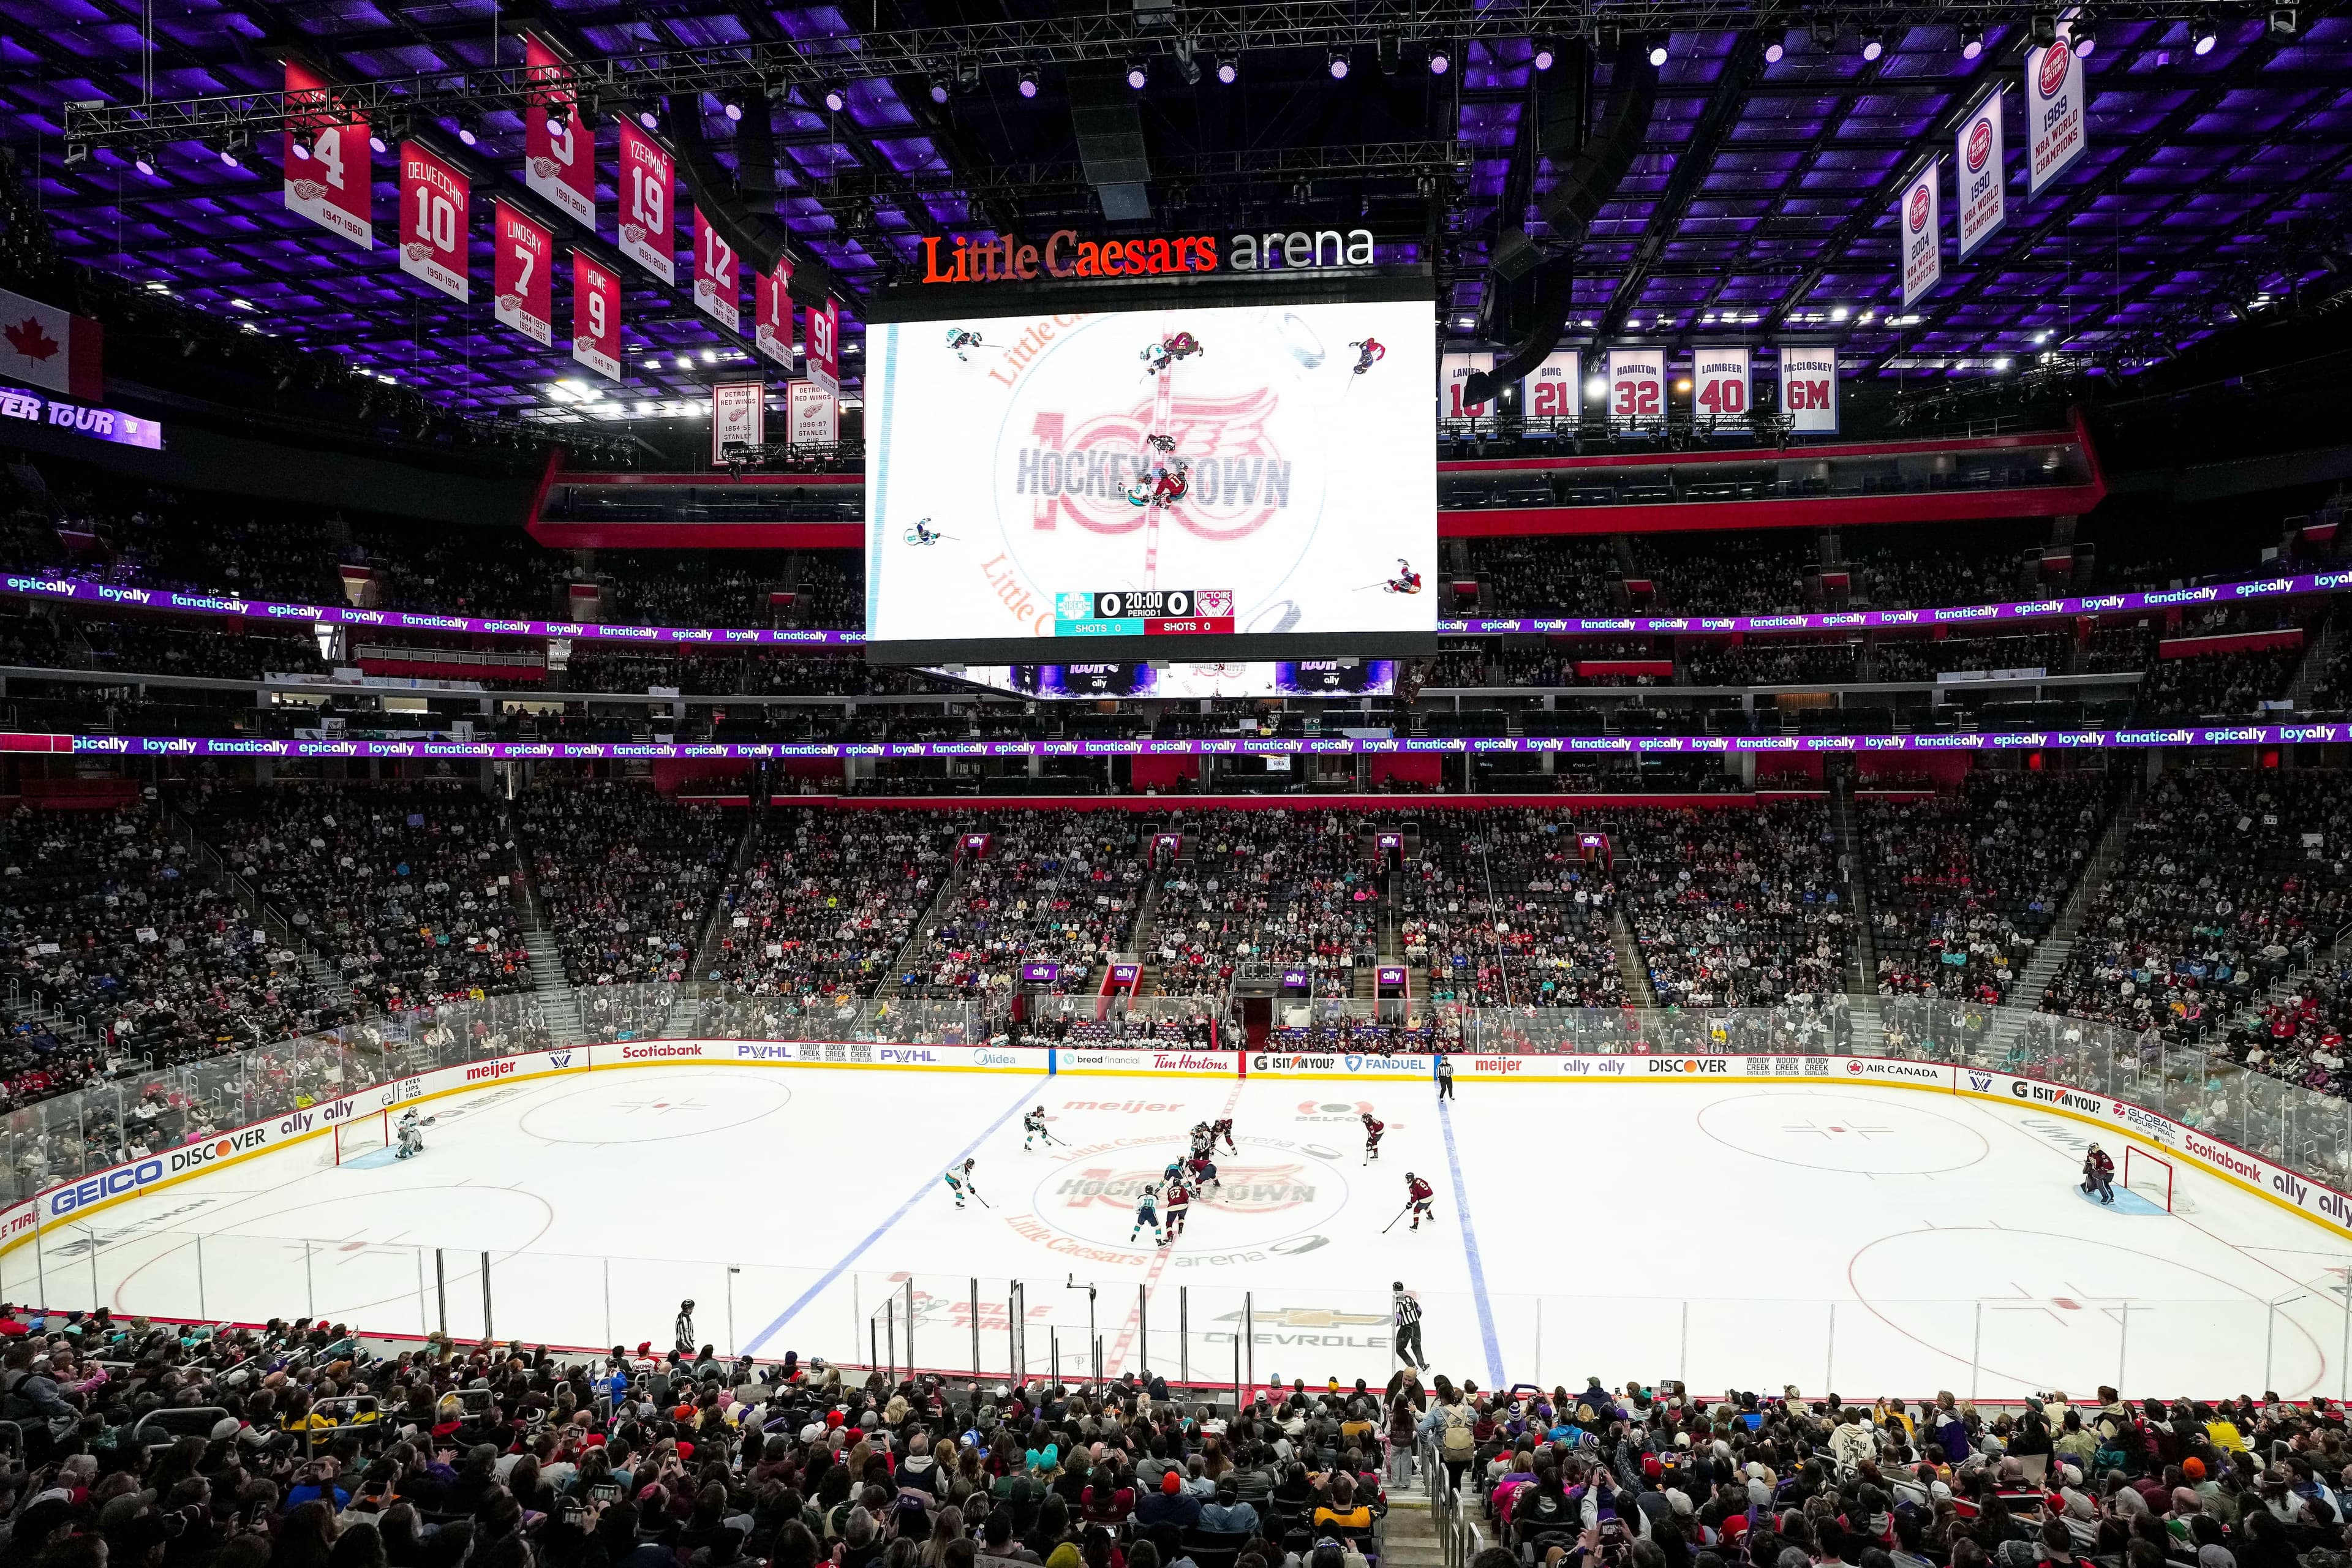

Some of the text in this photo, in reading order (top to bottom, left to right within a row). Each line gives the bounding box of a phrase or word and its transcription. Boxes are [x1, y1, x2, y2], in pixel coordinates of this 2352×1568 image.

[2044, 49, 2066, 75] DETROIT
[2044, 58, 2067, 86] PISTONS
[2043, 94, 2068, 133] 1989
[2035, 108, 2078, 159] NBA WORLD
[314, 127, 344, 190] 4
[630, 139, 666, 186] YZERMAN
[662, 152, 668, 165] C
[2035, 126, 2078, 176] CHAMPIONS
[407, 161, 464, 212] DELVECCHIO
[632, 165, 664, 235] 19
[1970, 171, 1990, 202] 1990
[556, 186, 587, 216] 1991-2012
[1964, 184, 1999, 225] NBA WORLD
[322, 207, 363, 237] 1947-1960
[416, 186, 455, 253] 10
[1964, 200, 1999, 240] CHAMPIONS
[507, 221, 541, 255] LINDSAY
[1912, 231, 1930, 260] 2004
[638, 246, 668, 274] 1983-2006
[704, 227, 731, 290] 12
[922, 228, 1375, 284] Little Caesars arena
[1907, 245, 1936, 279] NBA WORLD
[427, 266, 459, 292] 1950-1974
[514, 244, 534, 296] 7
[587, 269, 606, 294] HOWE
[1907, 260, 1936, 293] CHAMPIONS
[589, 291, 605, 339] 9
[771, 281, 780, 327] 1
[814, 312, 834, 364] 91
[1541, 366, 1562, 378] BING
[1616, 364, 1657, 377] HAMILTON
[1701, 363, 1743, 375] LAIMBEER
[1784, 361, 1834, 375] McCLOSKEY
[1534, 381, 1570, 417] 21
[1615, 380, 1659, 415] 32
[1697, 379, 1744, 414] 40
[1787, 379, 1831, 410] GM
[48, 401, 115, 435] TOUR
[8, 578, 827, 642] epically loyally fanatically epically loyally fanatically epically loyally fanatically epically loyally fanatically
[1101, 594, 1121, 617] 0
[1125, 592, 1163, 609] 20:00
[1167, 592, 1188, 616] 0
[1481, 579, 2293, 631] epically loyally fanatically epically loyally fanatically epically loyally fanatically epically loyally fanatically epically
[1075, 624, 1121, 633] SHOTS 0
[1163, 622, 1211, 631] SHOTS 0
[1091, 679, 1107, 688] ally
[1324, 676, 1340, 685] ally
[143, 725, 2335, 757] loyally fanatically epically loyally fanatically epically loyally fanatically epically loyally
[1381, 835, 1397, 845] ally
[1584, 835, 1600, 845] ally
[1033, 967, 1050, 979] ally
[1116, 967, 1134, 979] ally
[1286, 972, 1304, 985] ally
[1383, 969, 1401, 982] ally
[622, 1044, 703, 1058] Scotiabank
[737, 1045, 792, 1060] PWHL
[880, 1047, 937, 1063] PWHL
[974, 1049, 1016, 1065] Midea
[1077, 1055, 1140, 1065] bread financial
[1153, 1054, 1229, 1070] Tim Hortons
[1366, 1058, 1426, 1070] FANDUEL
[466, 1060, 516, 1080] meijer
[1476, 1057, 1522, 1074] meijer
[1563, 1059, 1625, 1076] ally ally
[1649, 1059, 1728, 1074] DISCOVER
[1866, 1064, 1938, 1079] AIR CANADA
[1968, 1069, 1993, 1078] PWHL
[281, 1099, 354, 1135] ally ally
[1063, 1100, 1185, 1114] meijer
[2128, 1108, 2176, 1133] GLOBAL
[2128, 1115, 2176, 1139] INDUSTRIAL
[172, 1128, 266, 1172] DISCOVER
[1232, 1134, 1295, 1149] arena
[2185, 1135, 2262, 1183] Scotiabank
[51, 1159, 163, 1216] GEICO
[1169, 1189, 1182, 1199] 27
[2272, 1174, 2308, 1205] ally
[11, 1210, 40, 1233] TIRE
[1005, 1212, 1148, 1266] Little Caesars
[1174, 1249, 1268, 1267] arena
